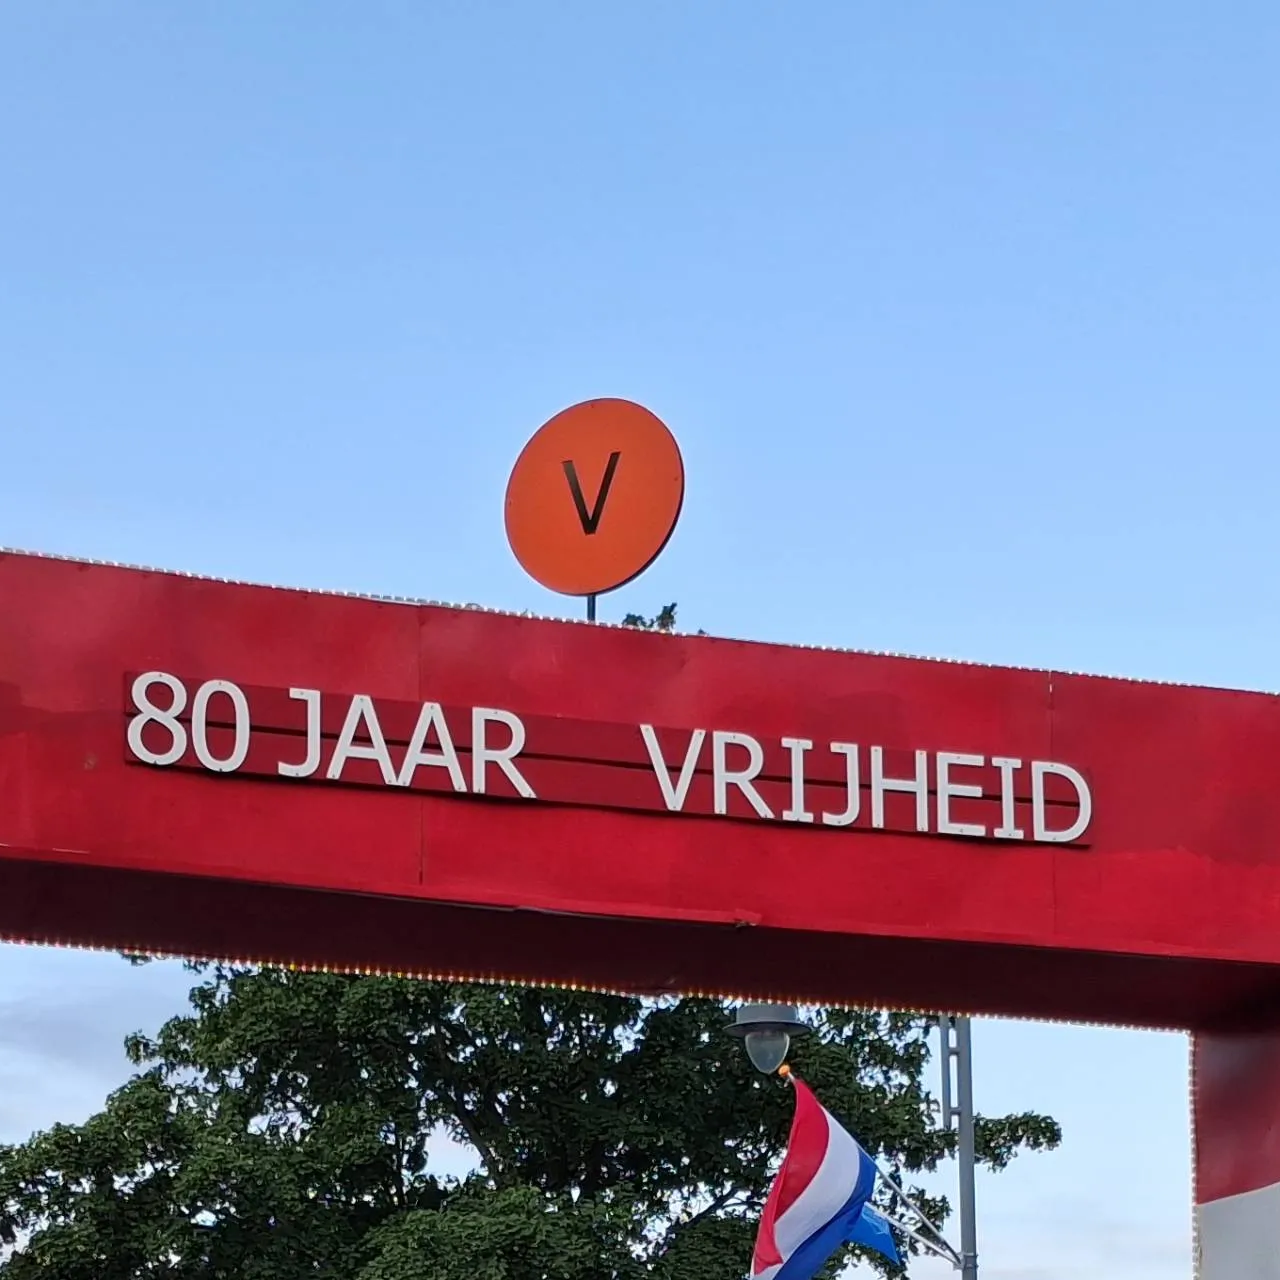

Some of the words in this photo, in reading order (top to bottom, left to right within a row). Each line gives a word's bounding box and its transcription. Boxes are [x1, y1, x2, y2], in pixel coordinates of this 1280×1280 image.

[562, 451, 621, 536] V
[127, 671, 251, 773] 80
[277, 688, 537, 800] JAAR
[639, 723, 1093, 843] VRIJHEID
